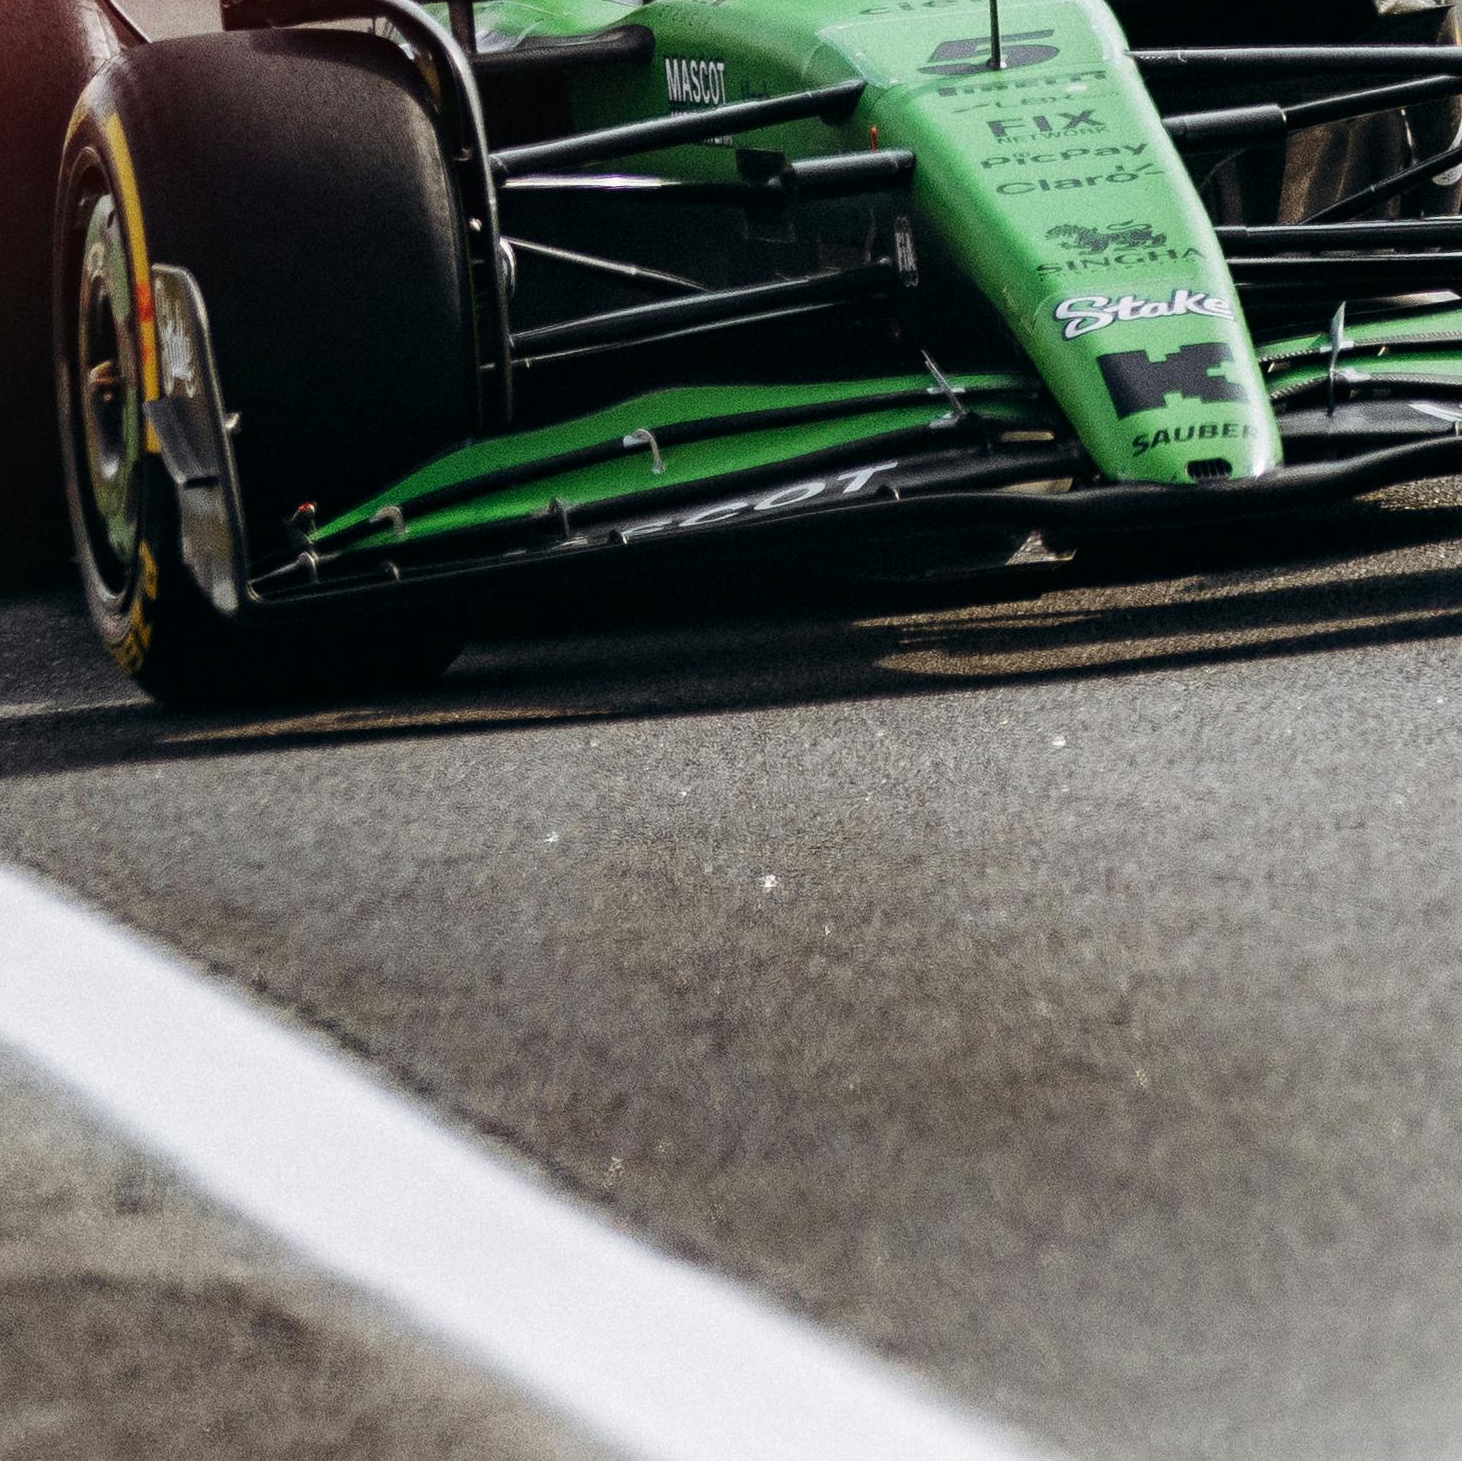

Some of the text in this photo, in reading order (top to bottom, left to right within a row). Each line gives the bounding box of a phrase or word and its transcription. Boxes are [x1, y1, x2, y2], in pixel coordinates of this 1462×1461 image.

[916, 28, 1060, 78] 5
[665, 58, 726, 106] MASCOT
[987, 109, 1107, 138] FIX
[997, 126, 1111, 145] NETWORK
[981, 142, 1149, 170] PicPay
[996, 171, 1141, 196] Claro
[1036, 248, 1207, 276] SINGHA
[1053, 288, 1236, 341] Stake
